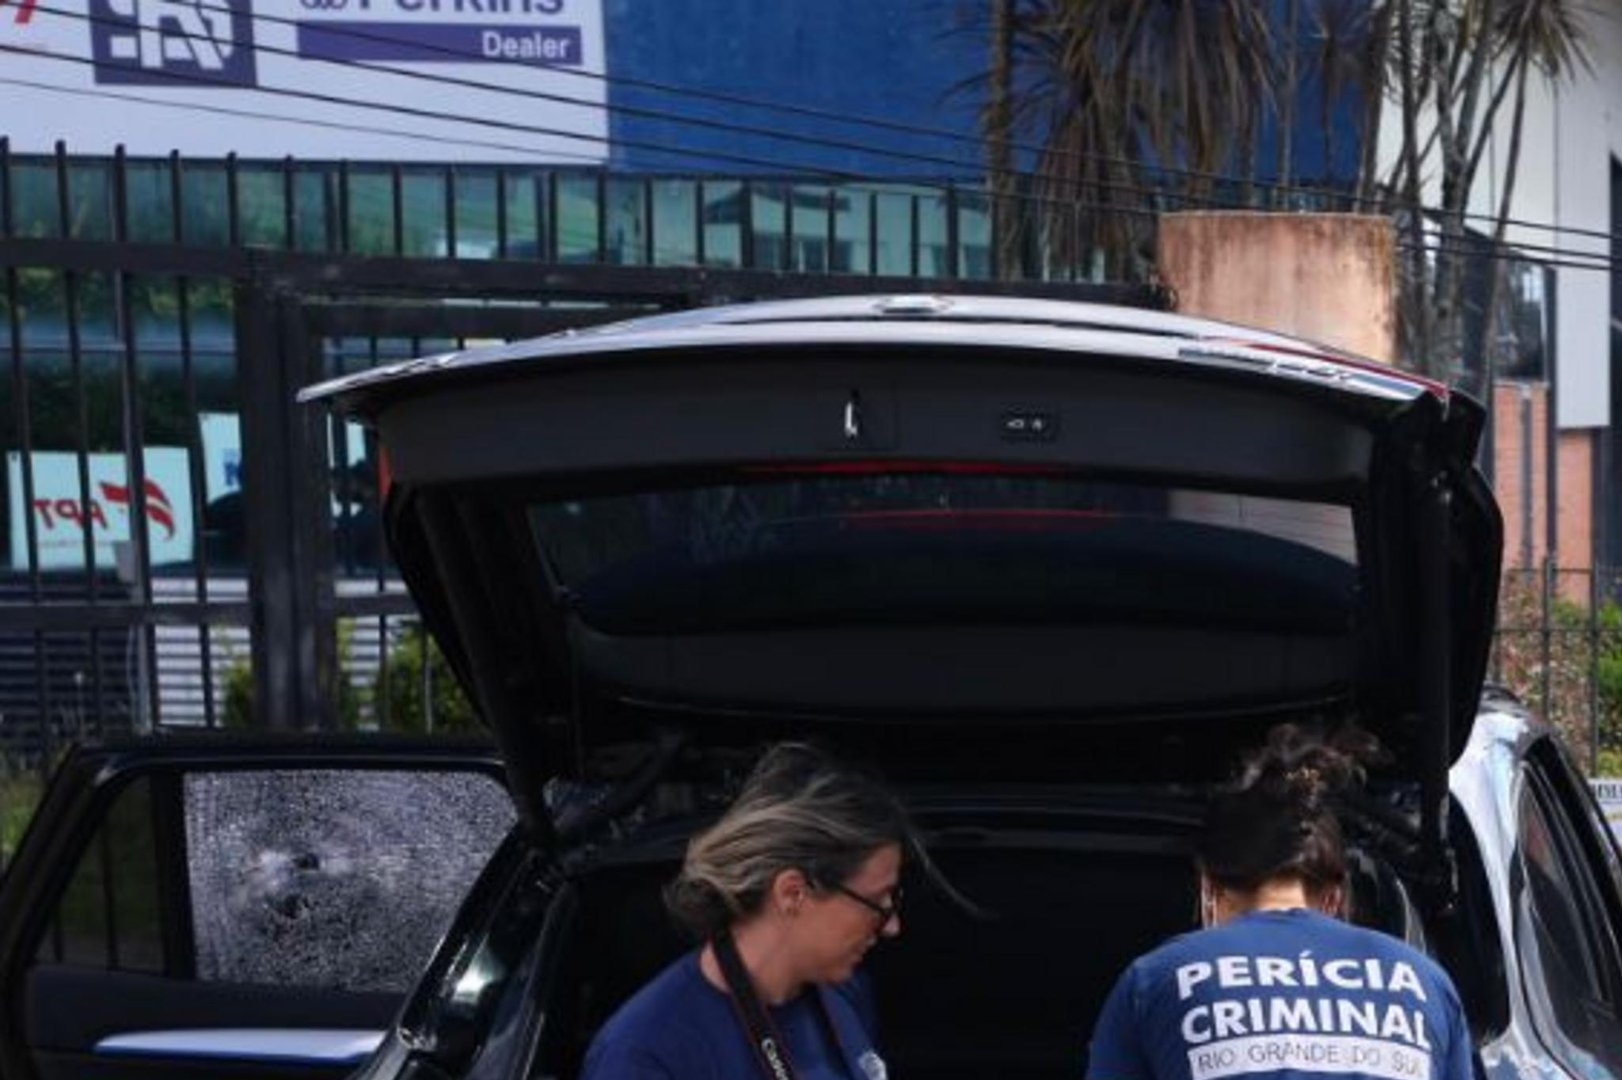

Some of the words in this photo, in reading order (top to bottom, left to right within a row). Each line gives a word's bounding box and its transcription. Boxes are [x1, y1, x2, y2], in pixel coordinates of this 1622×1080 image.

[481, 30, 571, 59] Dealer
[1176, 950, 1426, 1002] PERÍCIA
[1181, 996, 1431, 1049] CRIMINAL
[1199, 1048, 1235, 1073] RIO
[1249, 1041, 1341, 1064] GRANDE
[1352, 1047, 1381, 1065] DO
